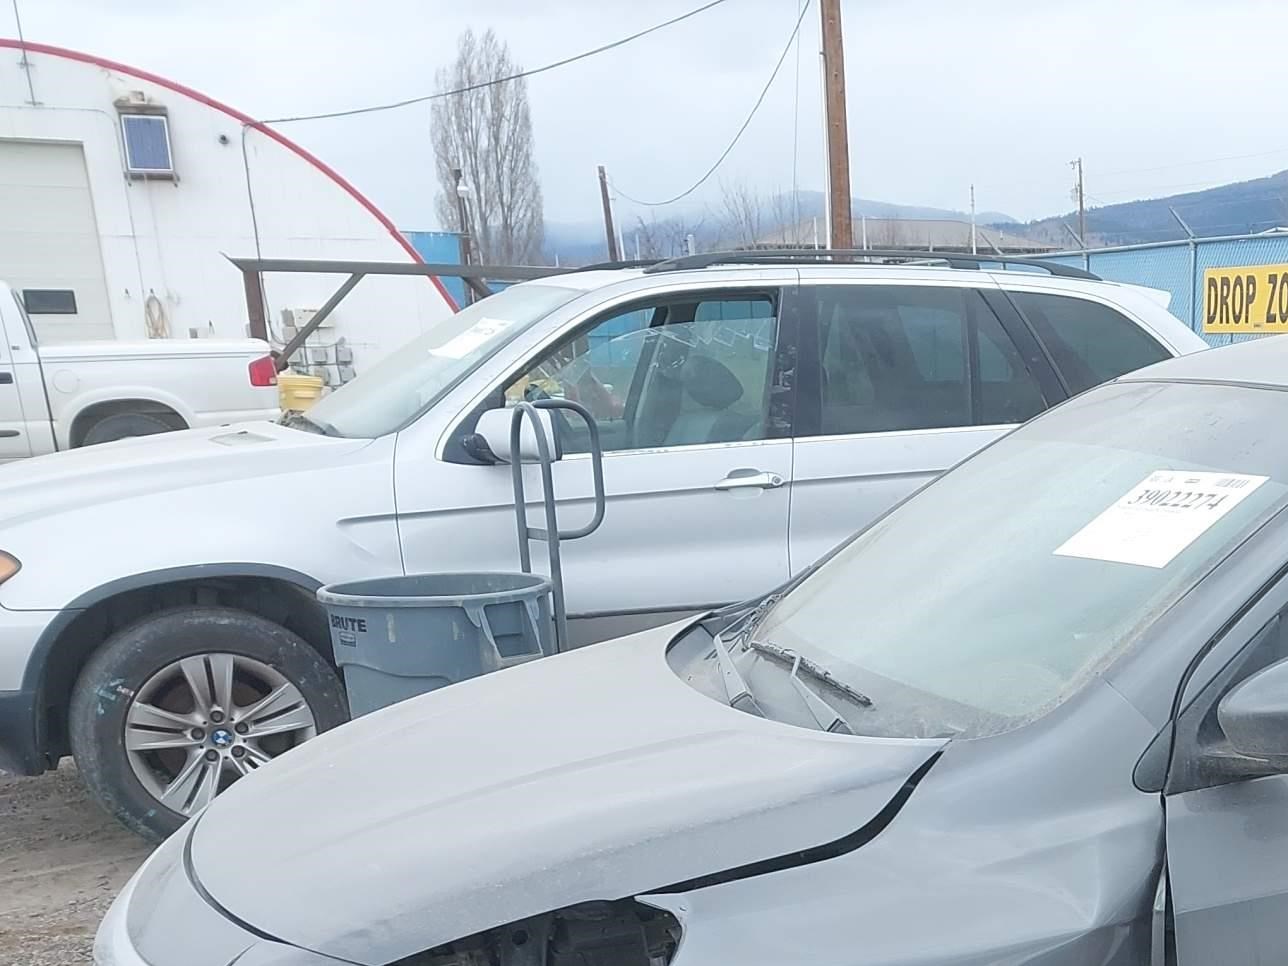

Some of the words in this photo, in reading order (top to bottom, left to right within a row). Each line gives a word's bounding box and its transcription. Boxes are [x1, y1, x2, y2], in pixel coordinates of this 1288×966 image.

[1206, 274, 1257, 325] DROP
[1127, 488, 1229, 511] 39022274
[330, 613, 368, 633] BRUTE
